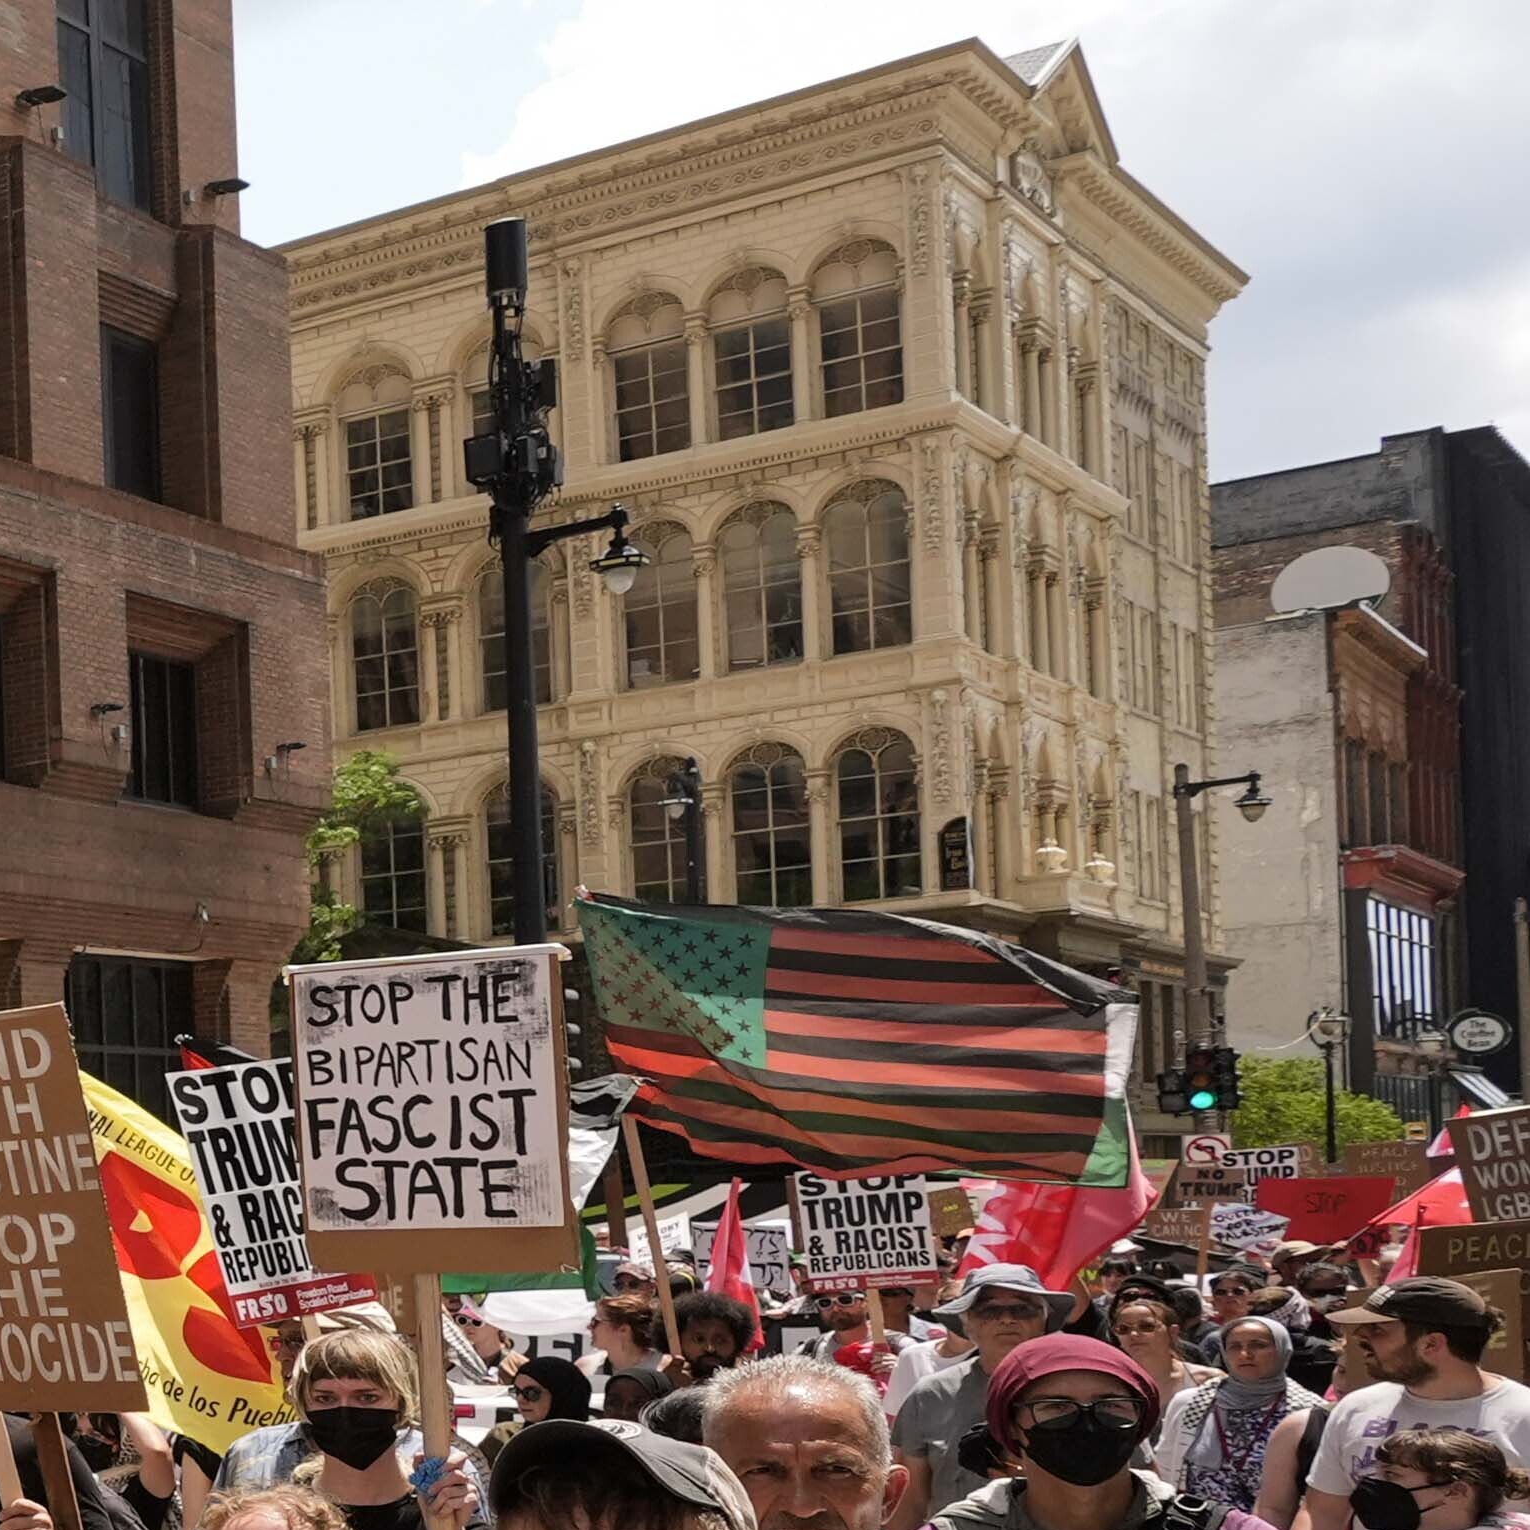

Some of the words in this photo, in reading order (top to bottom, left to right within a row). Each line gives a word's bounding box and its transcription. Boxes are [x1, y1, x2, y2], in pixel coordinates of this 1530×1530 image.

[306, 981, 414, 1027] STOP
[424, 974, 520, 1025] THE
[306, 1037, 532, 1088] BIPARTISAN
[304, 1088, 537, 1159] FASCIST
[114, 1125, 178, 1174] LEAGUE
[187, 1118, 300, 1195] TRUM
[1222, 1148, 1295, 1167] STOP
[335, 1157, 519, 1221] STATE
[1180, 1181, 1243, 1197] TRUMP
[1197, 1169, 1225, 1181] NO
[211, 1203, 232, 1249] &
[237, 1184, 304, 1243] RAC
[801, 1191, 924, 1231] TRUMP
[1151, 1223, 1183, 1238] CAN
[1160, 1212, 1191, 1223] WE
[221, 1240, 310, 1284] REPUBLI
[808, 1235, 825, 1257] &
[835, 1226, 927, 1255] RACIST
[810, 1249, 931, 1274] REPUBLICANS
[1447, 1228, 1530, 1264] PEAC
[162, 1371, 186, 1402] de
[189, 1385, 220, 1418] los
